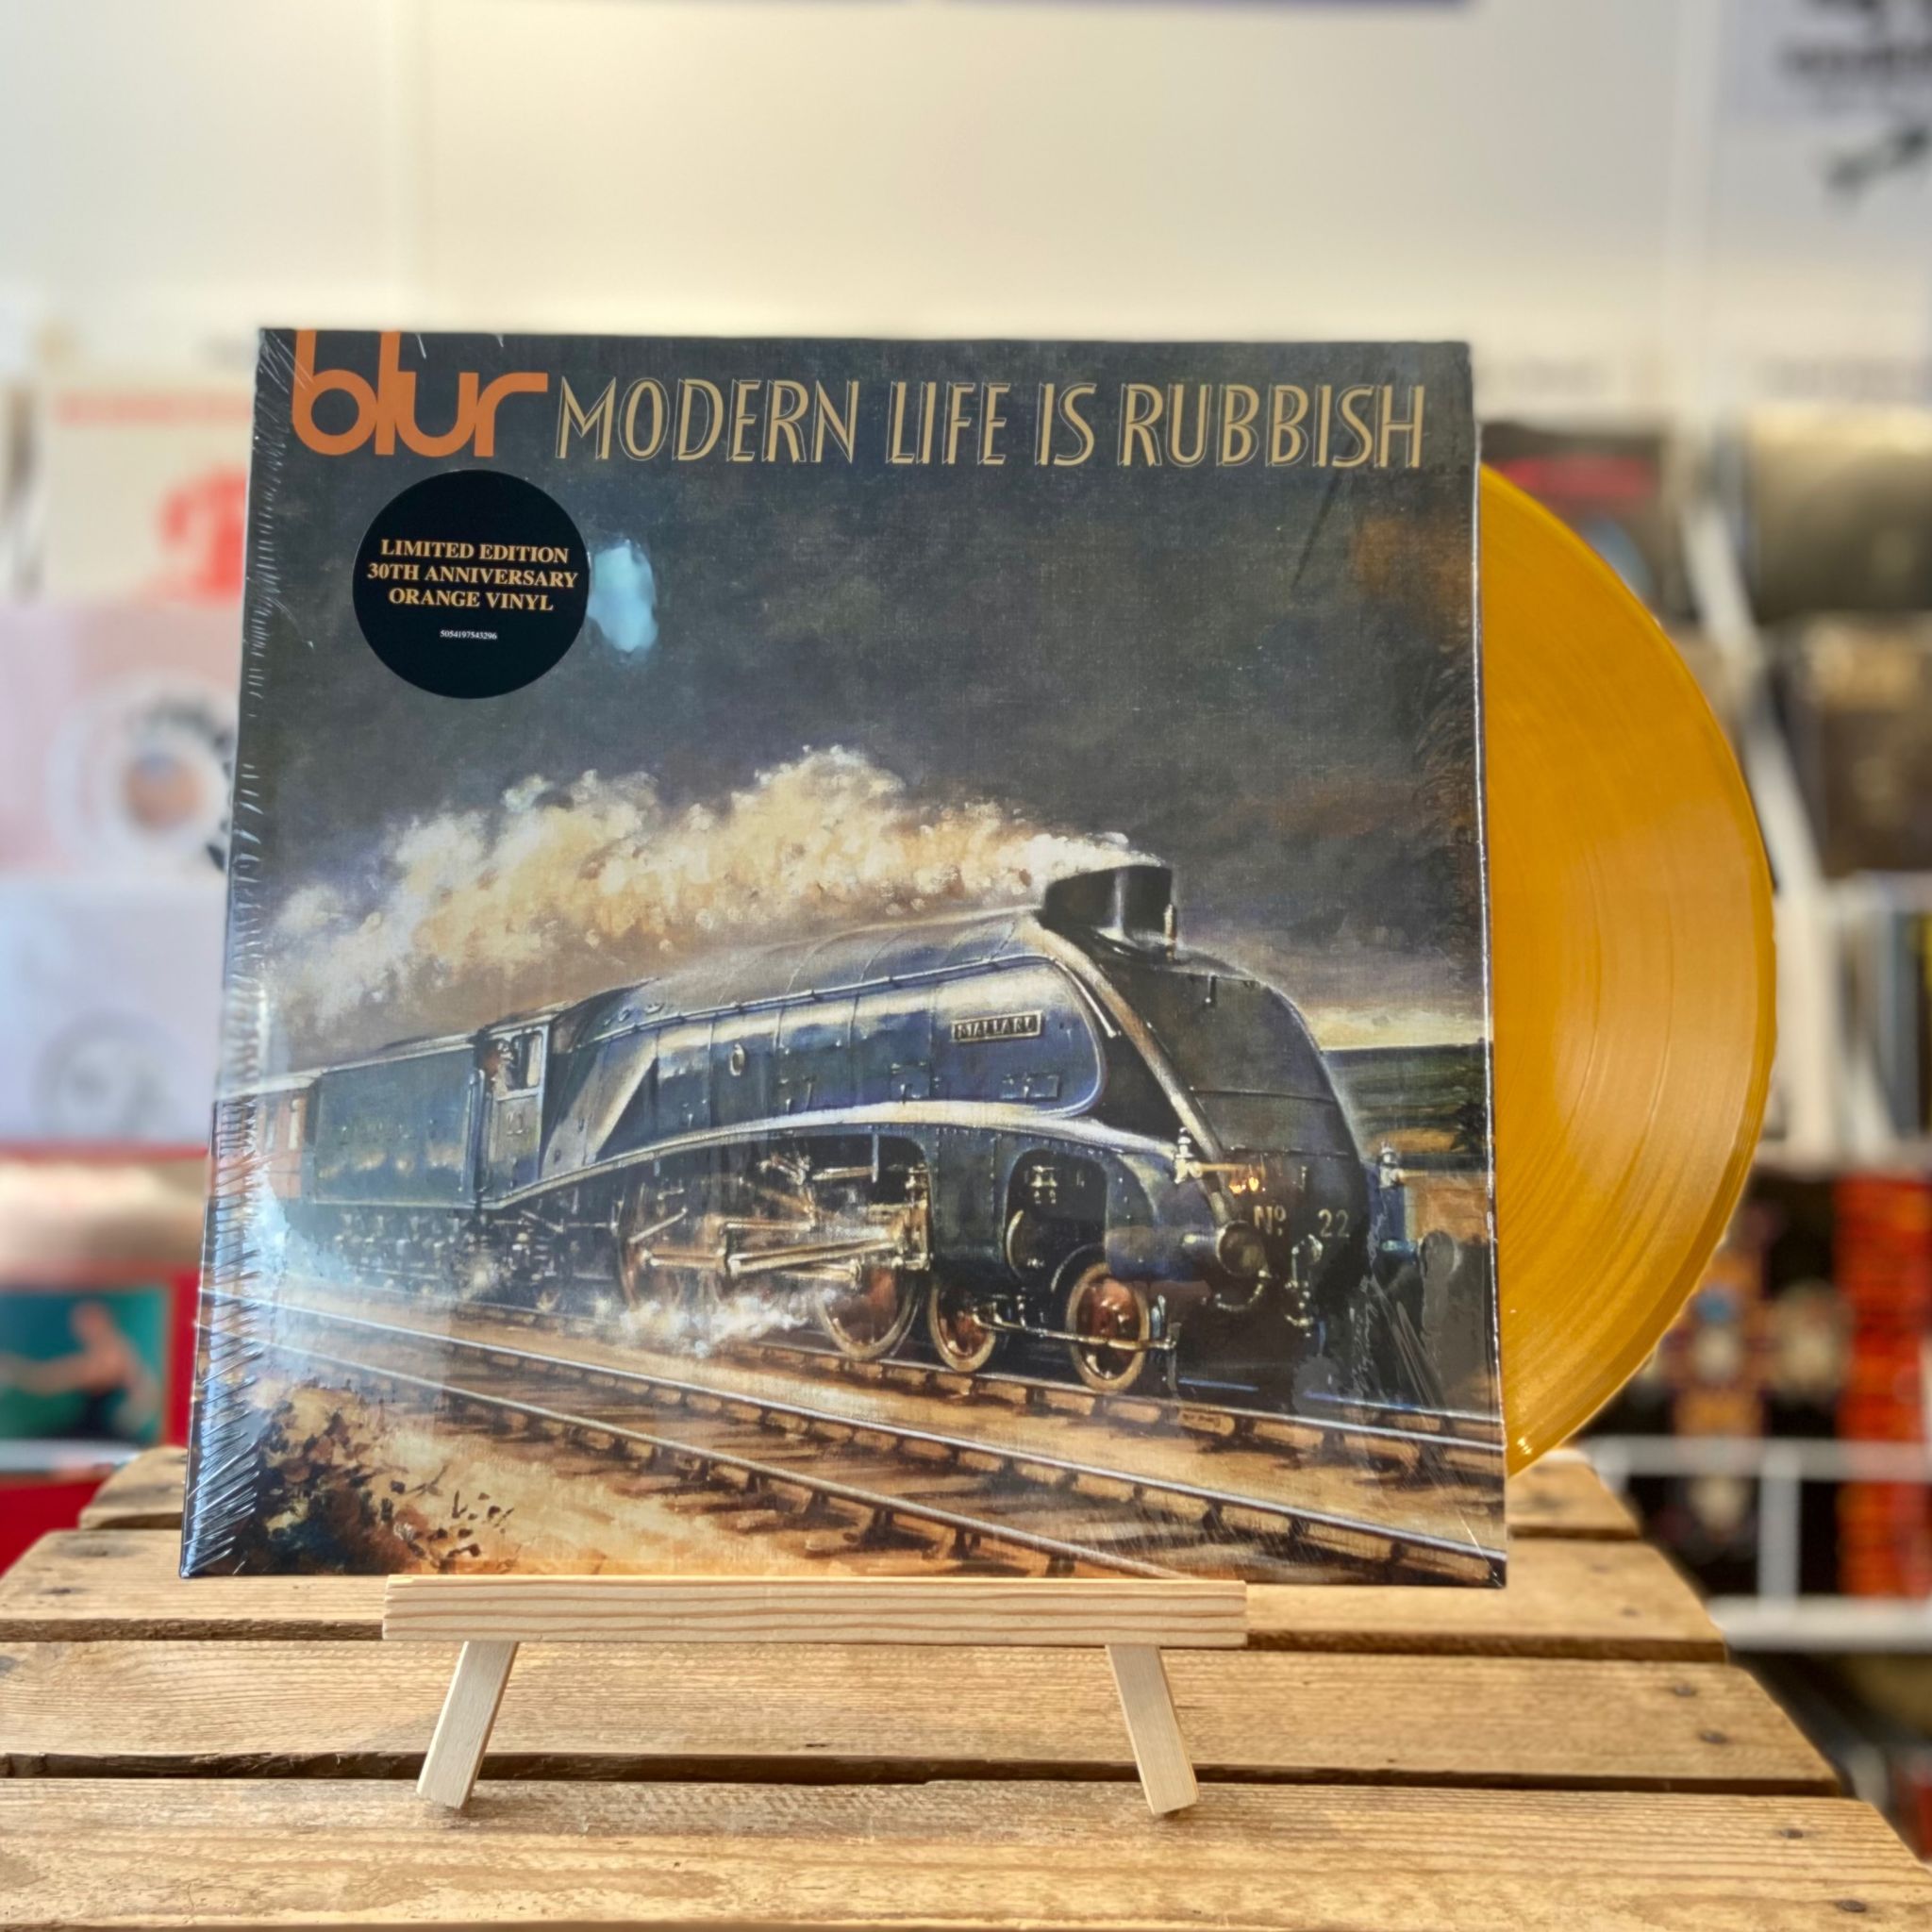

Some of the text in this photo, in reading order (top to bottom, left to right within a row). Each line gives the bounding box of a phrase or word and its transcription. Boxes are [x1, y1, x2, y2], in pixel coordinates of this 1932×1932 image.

[292, 330, 548, 457] blur
[556, 377, 1424, 469] MODERN LIFE IS RUBBISH
[380, 539, 569, 563] LIMITED EDITION
[367, 563, 578, 588] 30TH ANNIVERSARY
[389, 588, 554, 610] ORANGE VINYL
[440, 629, 497, 640] 5054197543296
[1318, 1208, 1350, 1238] 22
